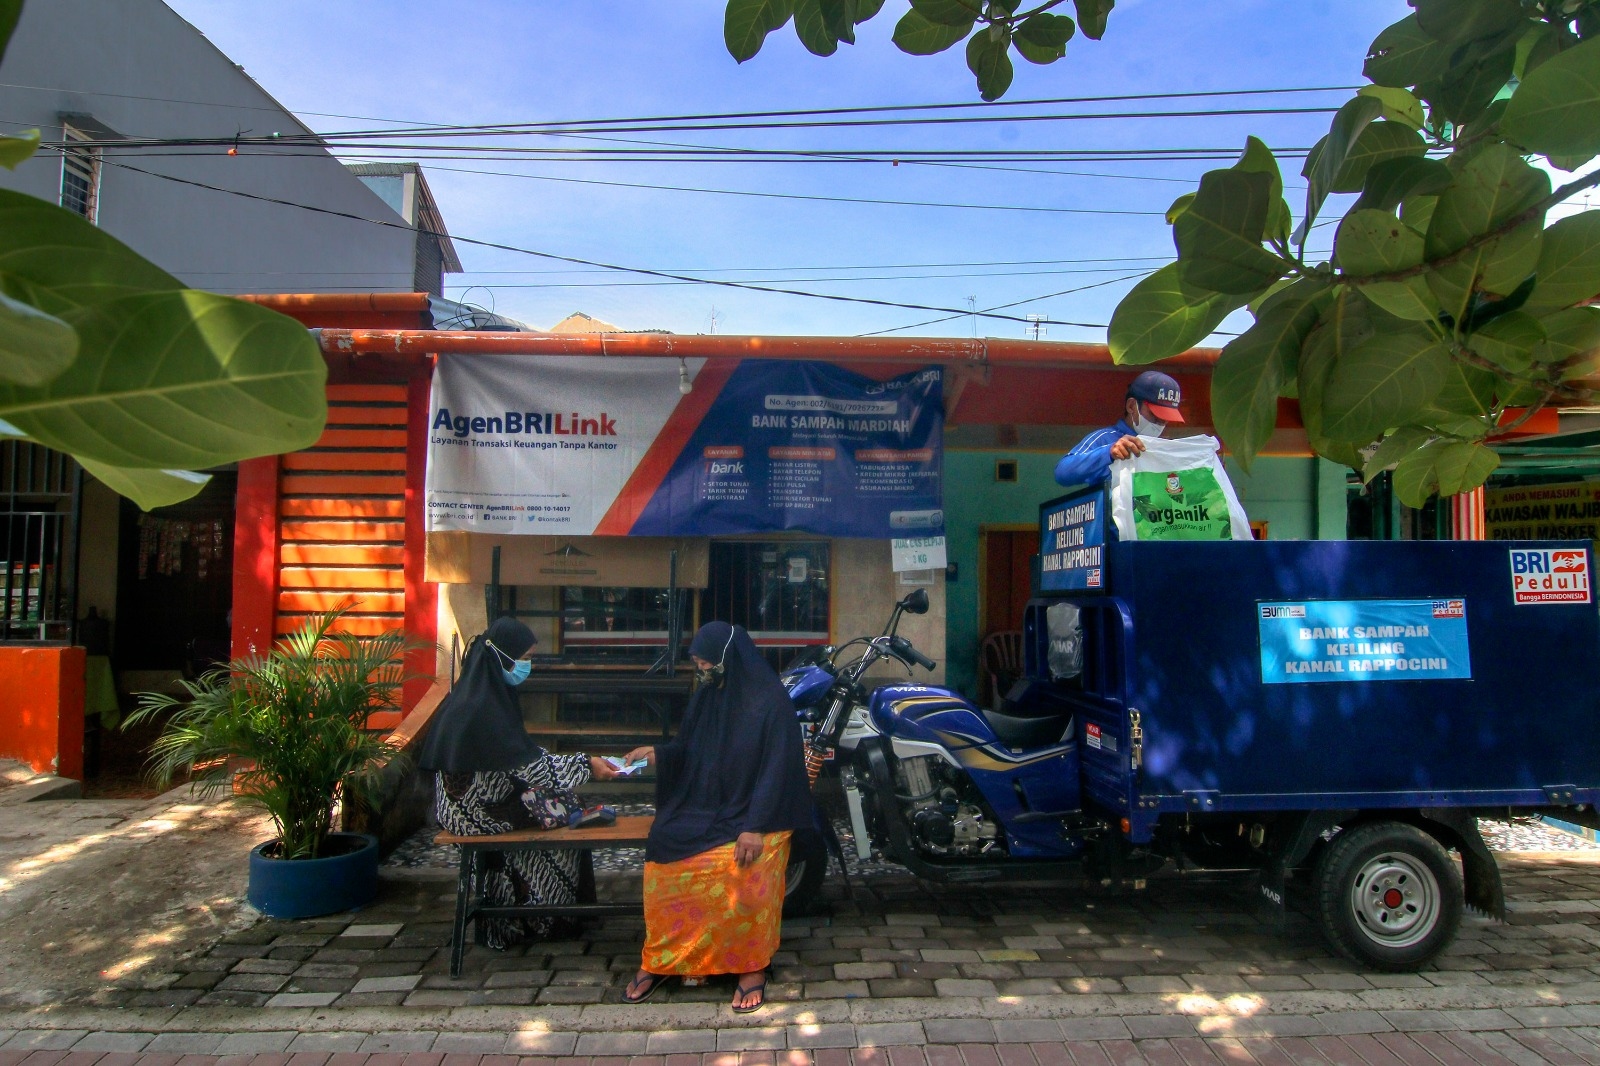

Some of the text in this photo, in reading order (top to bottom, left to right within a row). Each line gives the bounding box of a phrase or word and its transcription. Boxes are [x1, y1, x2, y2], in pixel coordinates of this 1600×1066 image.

[923, 370, 940, 382] BRI
[786, 399, 808, 408] Agen:
[432, 408, 617, 438] AgenBRILink
[752, 415, 910, 432] BANK SAMPAH MARDIAH
[431, 436, 617, 451] Layanan Transaksi Keuangan Tanpa Kantor
[1529, 488, 1580, 499] MEMASUKI
[1048, 501, 1095, 530] BANK SAMPAH
[1149, 504, 1210, 525] organik
[1486, 502, 1600, 522] KAWASAN WAJIB
[1056, 527, 1084, 549] KELILING
[1493, 525, 1598, 540] PAKAI MASKER
[918, 554, 927, 563] KG
[1043, 546, 1100, 571] KANAL RAPPOCINI
[1512, 552, 1550, 573] BRI
[1514, 574, 1587, 590] Peduli
[1299, 625, 1429, 640] BANK SAMPAH
[1327, 642, 1405, 656] KELILING
[1285, 658, 1447, 673] KANAL RAPPOCINI
[1261, 885, 1281, 905] VIAR
